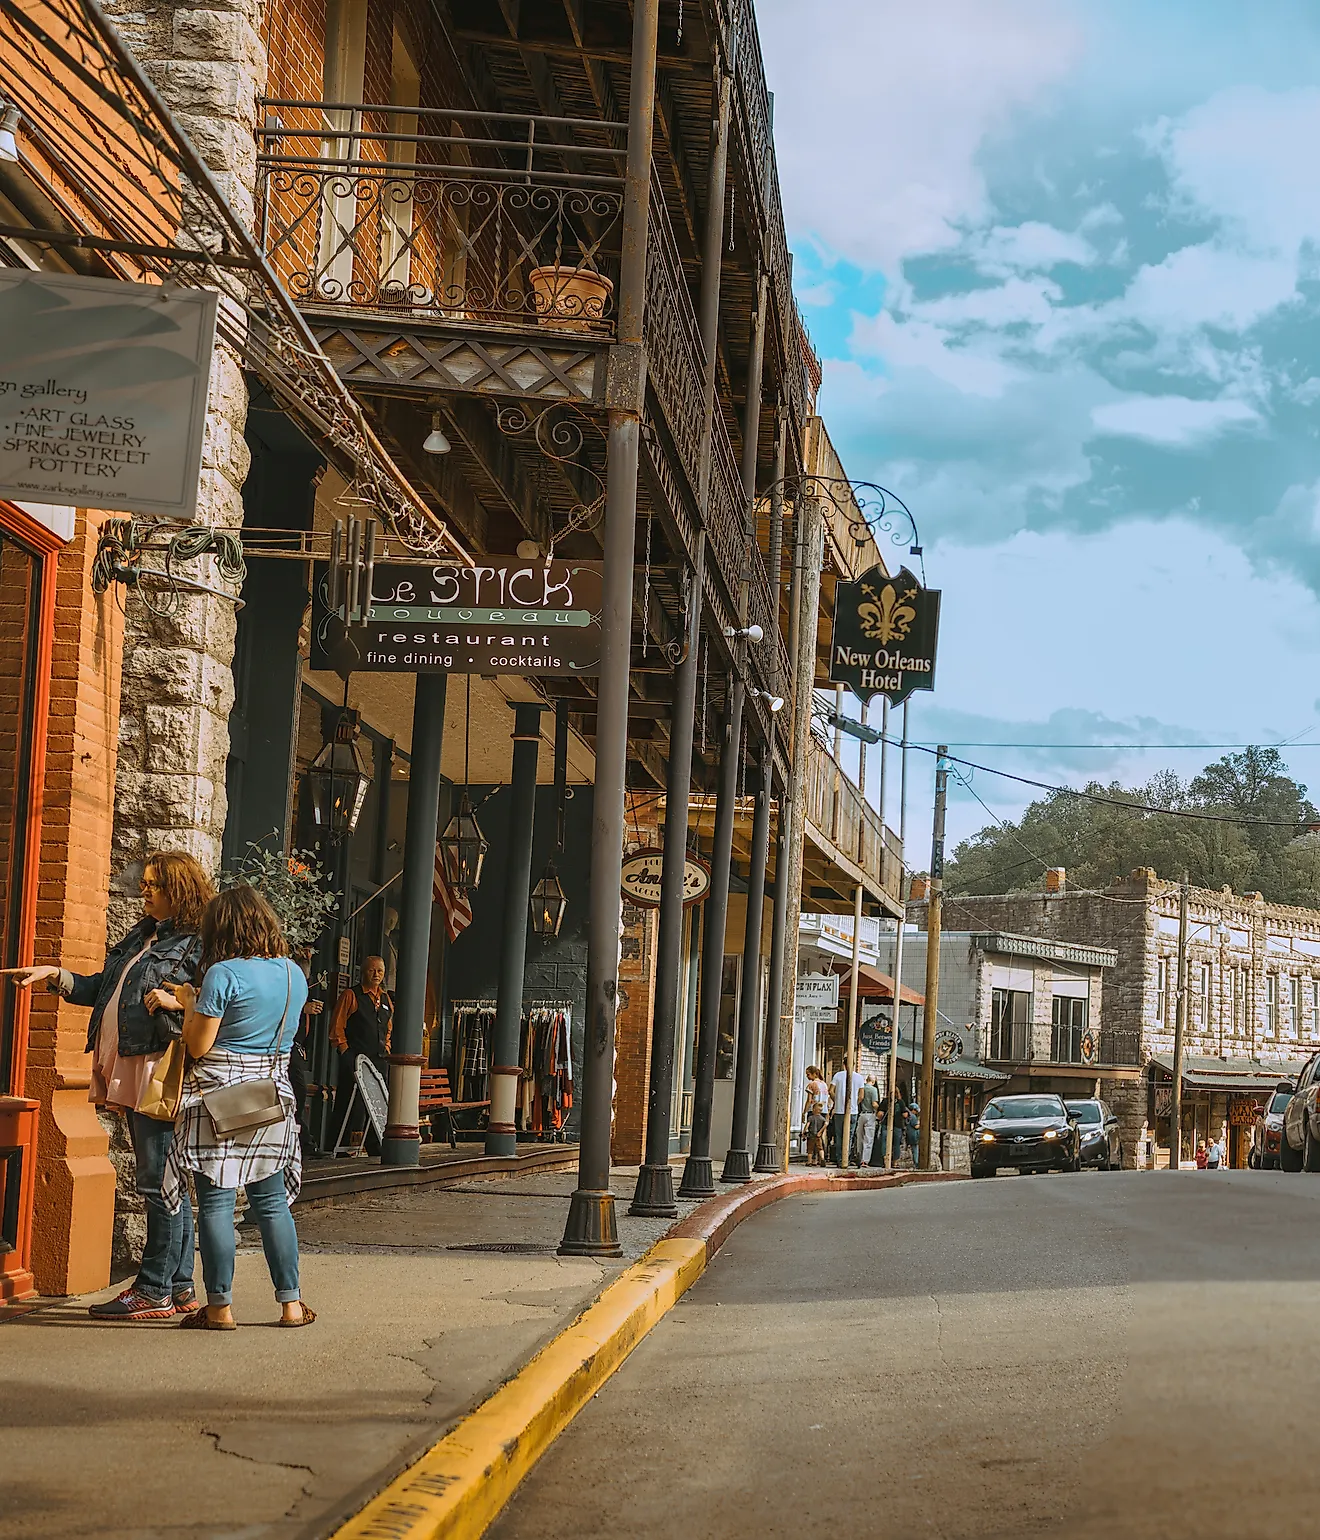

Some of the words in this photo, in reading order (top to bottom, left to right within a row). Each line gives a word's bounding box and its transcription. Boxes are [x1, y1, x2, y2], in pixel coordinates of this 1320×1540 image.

[20, 379, 87, 404] gallery
[24, 408, 65, 423] ART
[70, 412, 135, 431] GLASS
[14, 422, 54, 439] FINE
[59, 427, 147, 448] JEWELRY
[2, 437, 70, 457] SPRING
[74, 446, 150, 465] STREET
[29, 457, 122, 478] POTTERY
[17, 481, 127, 500] www.zarksgallery.com
[430, 566, 573, 607] STICK
[378, 631, 551, 648] restaurant
[367, 651, 397, 665] fine
[403, 652, 453, 668] dining
[490, 655, 561, 668] cocktails
[835, 645, 871, 667] New
[875, 648, 931, 673] Orleans
[860, 668, 903, 691] Hotel
